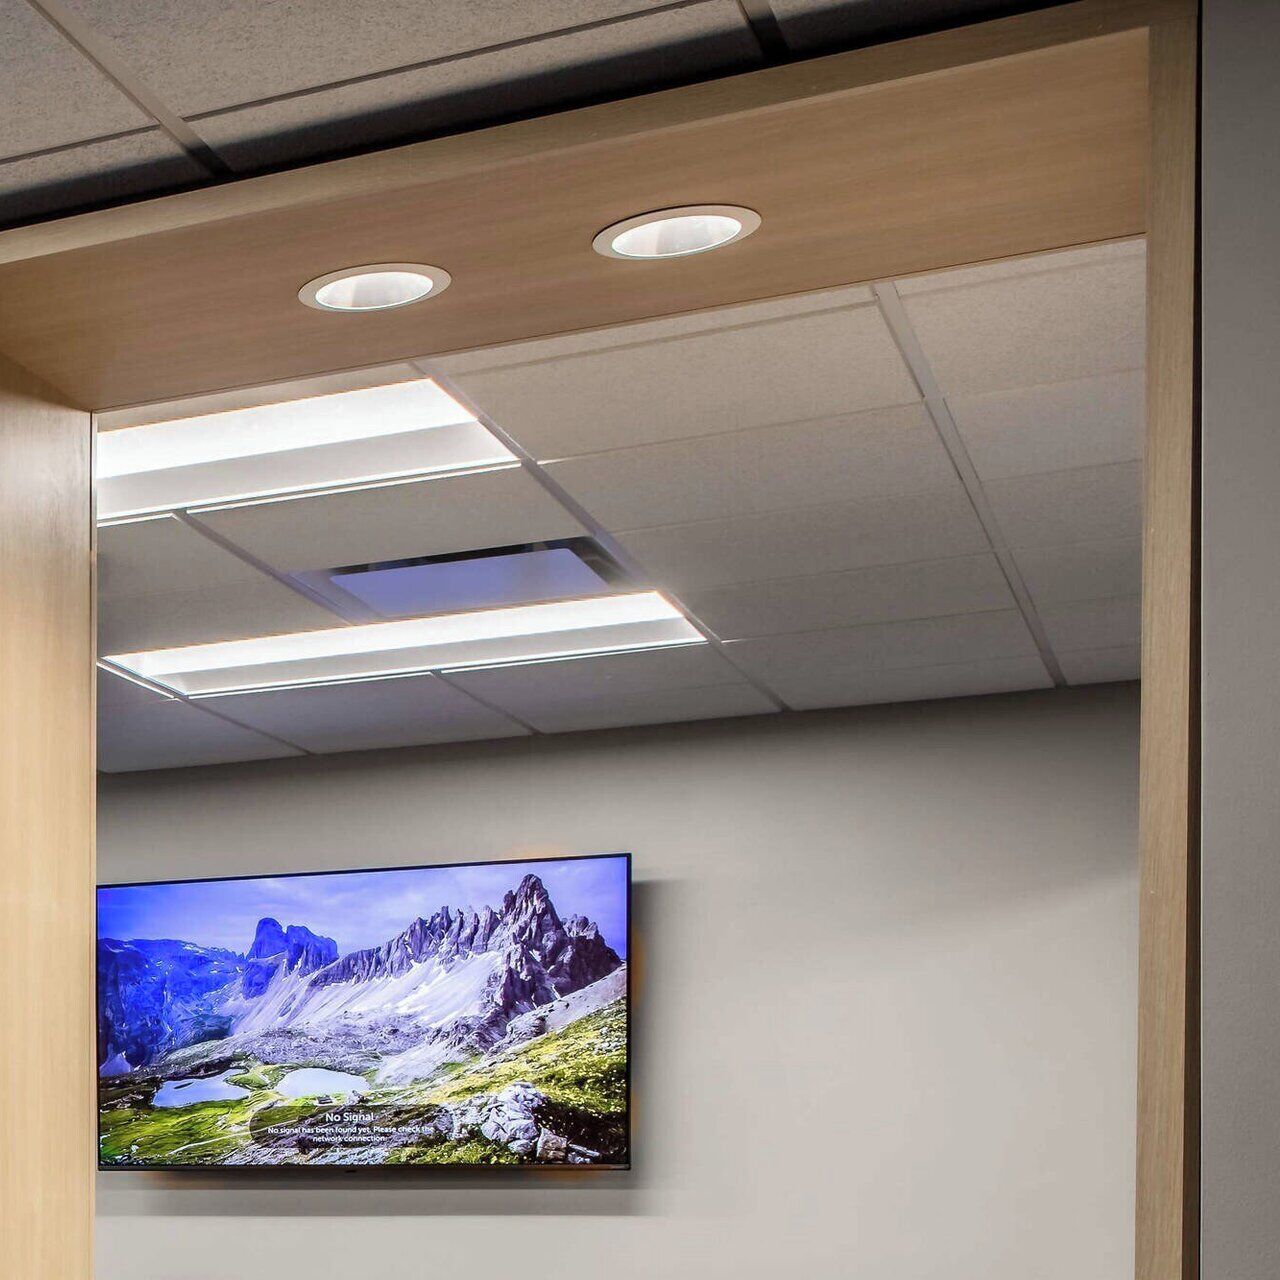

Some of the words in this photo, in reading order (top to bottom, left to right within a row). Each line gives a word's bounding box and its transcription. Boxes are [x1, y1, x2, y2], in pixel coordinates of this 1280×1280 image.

[325, 1113, 341, 1122] No
[343, 1112, 374, 1124] Signal
[279, 1127, 301, 1135] signal
[315, 1126, 334, 1134] been
[398, 1125, 420, 1133] check
